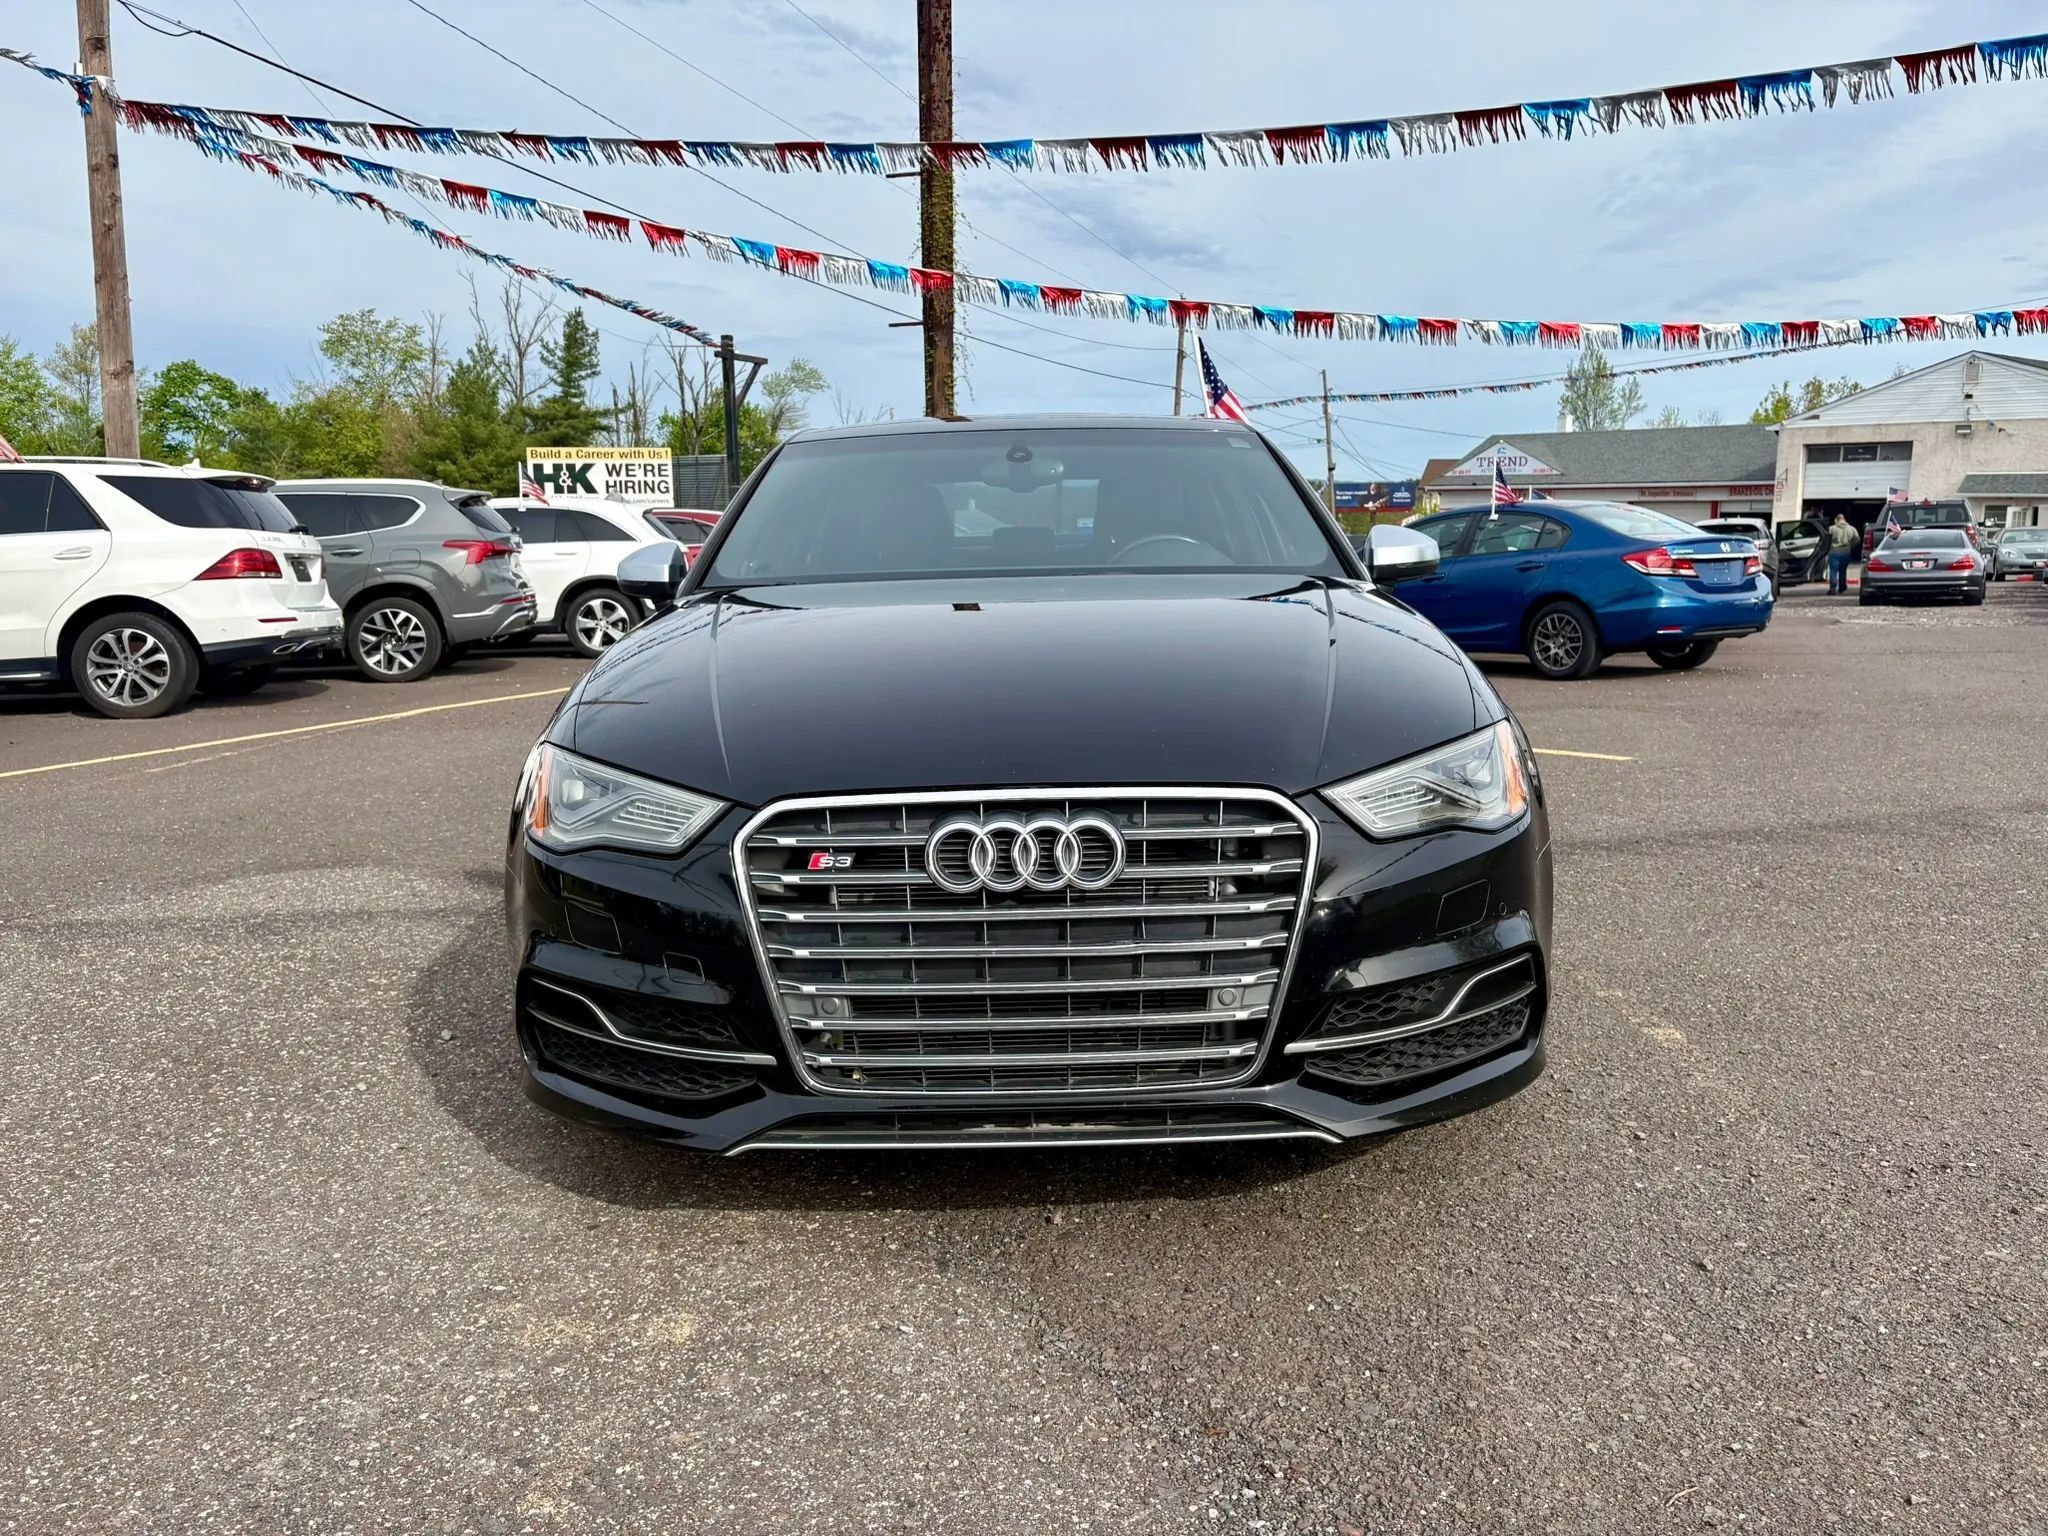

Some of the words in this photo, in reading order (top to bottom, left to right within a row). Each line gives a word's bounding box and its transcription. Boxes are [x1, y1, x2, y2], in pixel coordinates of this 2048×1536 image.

[530, 449, 561, 459] Build
[565, 451, 572, 459] a
[576, 449, 614, 459] Career
[619, 449, 645, 459] with
[1476, 456, 1528, 467] TREND
[605, 463, 669, 477] WE'RE
[533, 463, 599, 494] H&K
[605, 480, 670, 494] HIRING
[818, 856, 852, 867] S3
